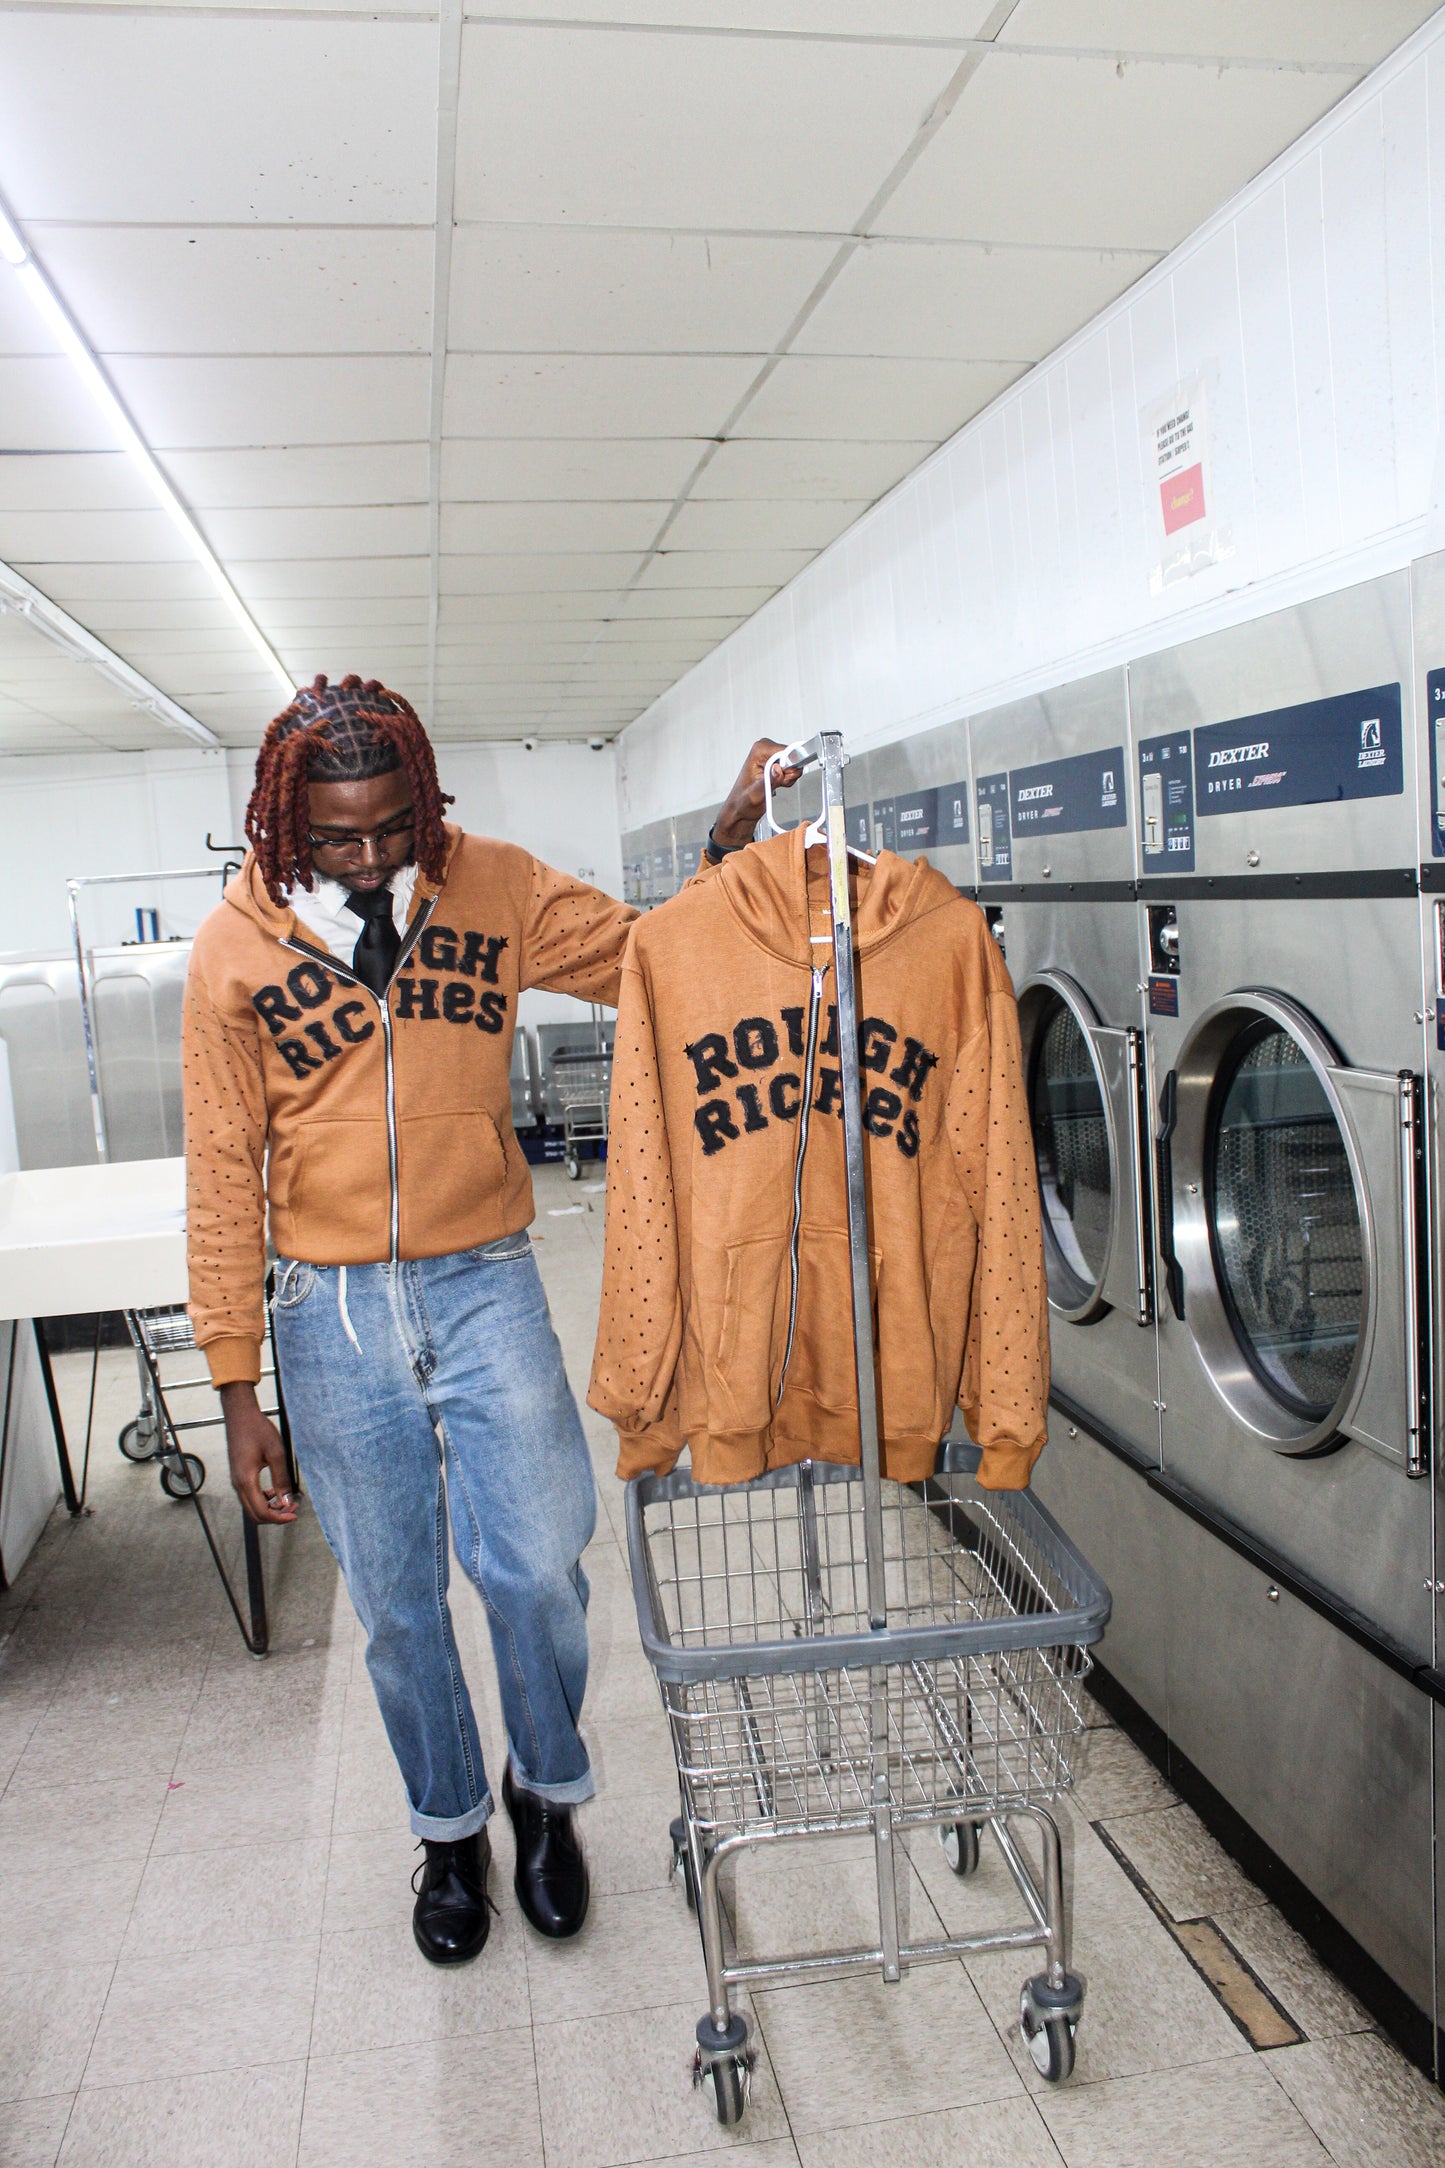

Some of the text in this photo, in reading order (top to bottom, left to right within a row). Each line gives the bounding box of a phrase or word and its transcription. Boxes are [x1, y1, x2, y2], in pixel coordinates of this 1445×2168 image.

[1208, 742, 1269, 768] DEXTER
[1358, 749, 1386, 760] DEXTER
[1018, 784, 1053, 802] DEXTER
[1208, 778, 1242, 793] DRYER
[900, 808, 924, 822] DEXTER
[248, 925, 503, 1036] ROGH
